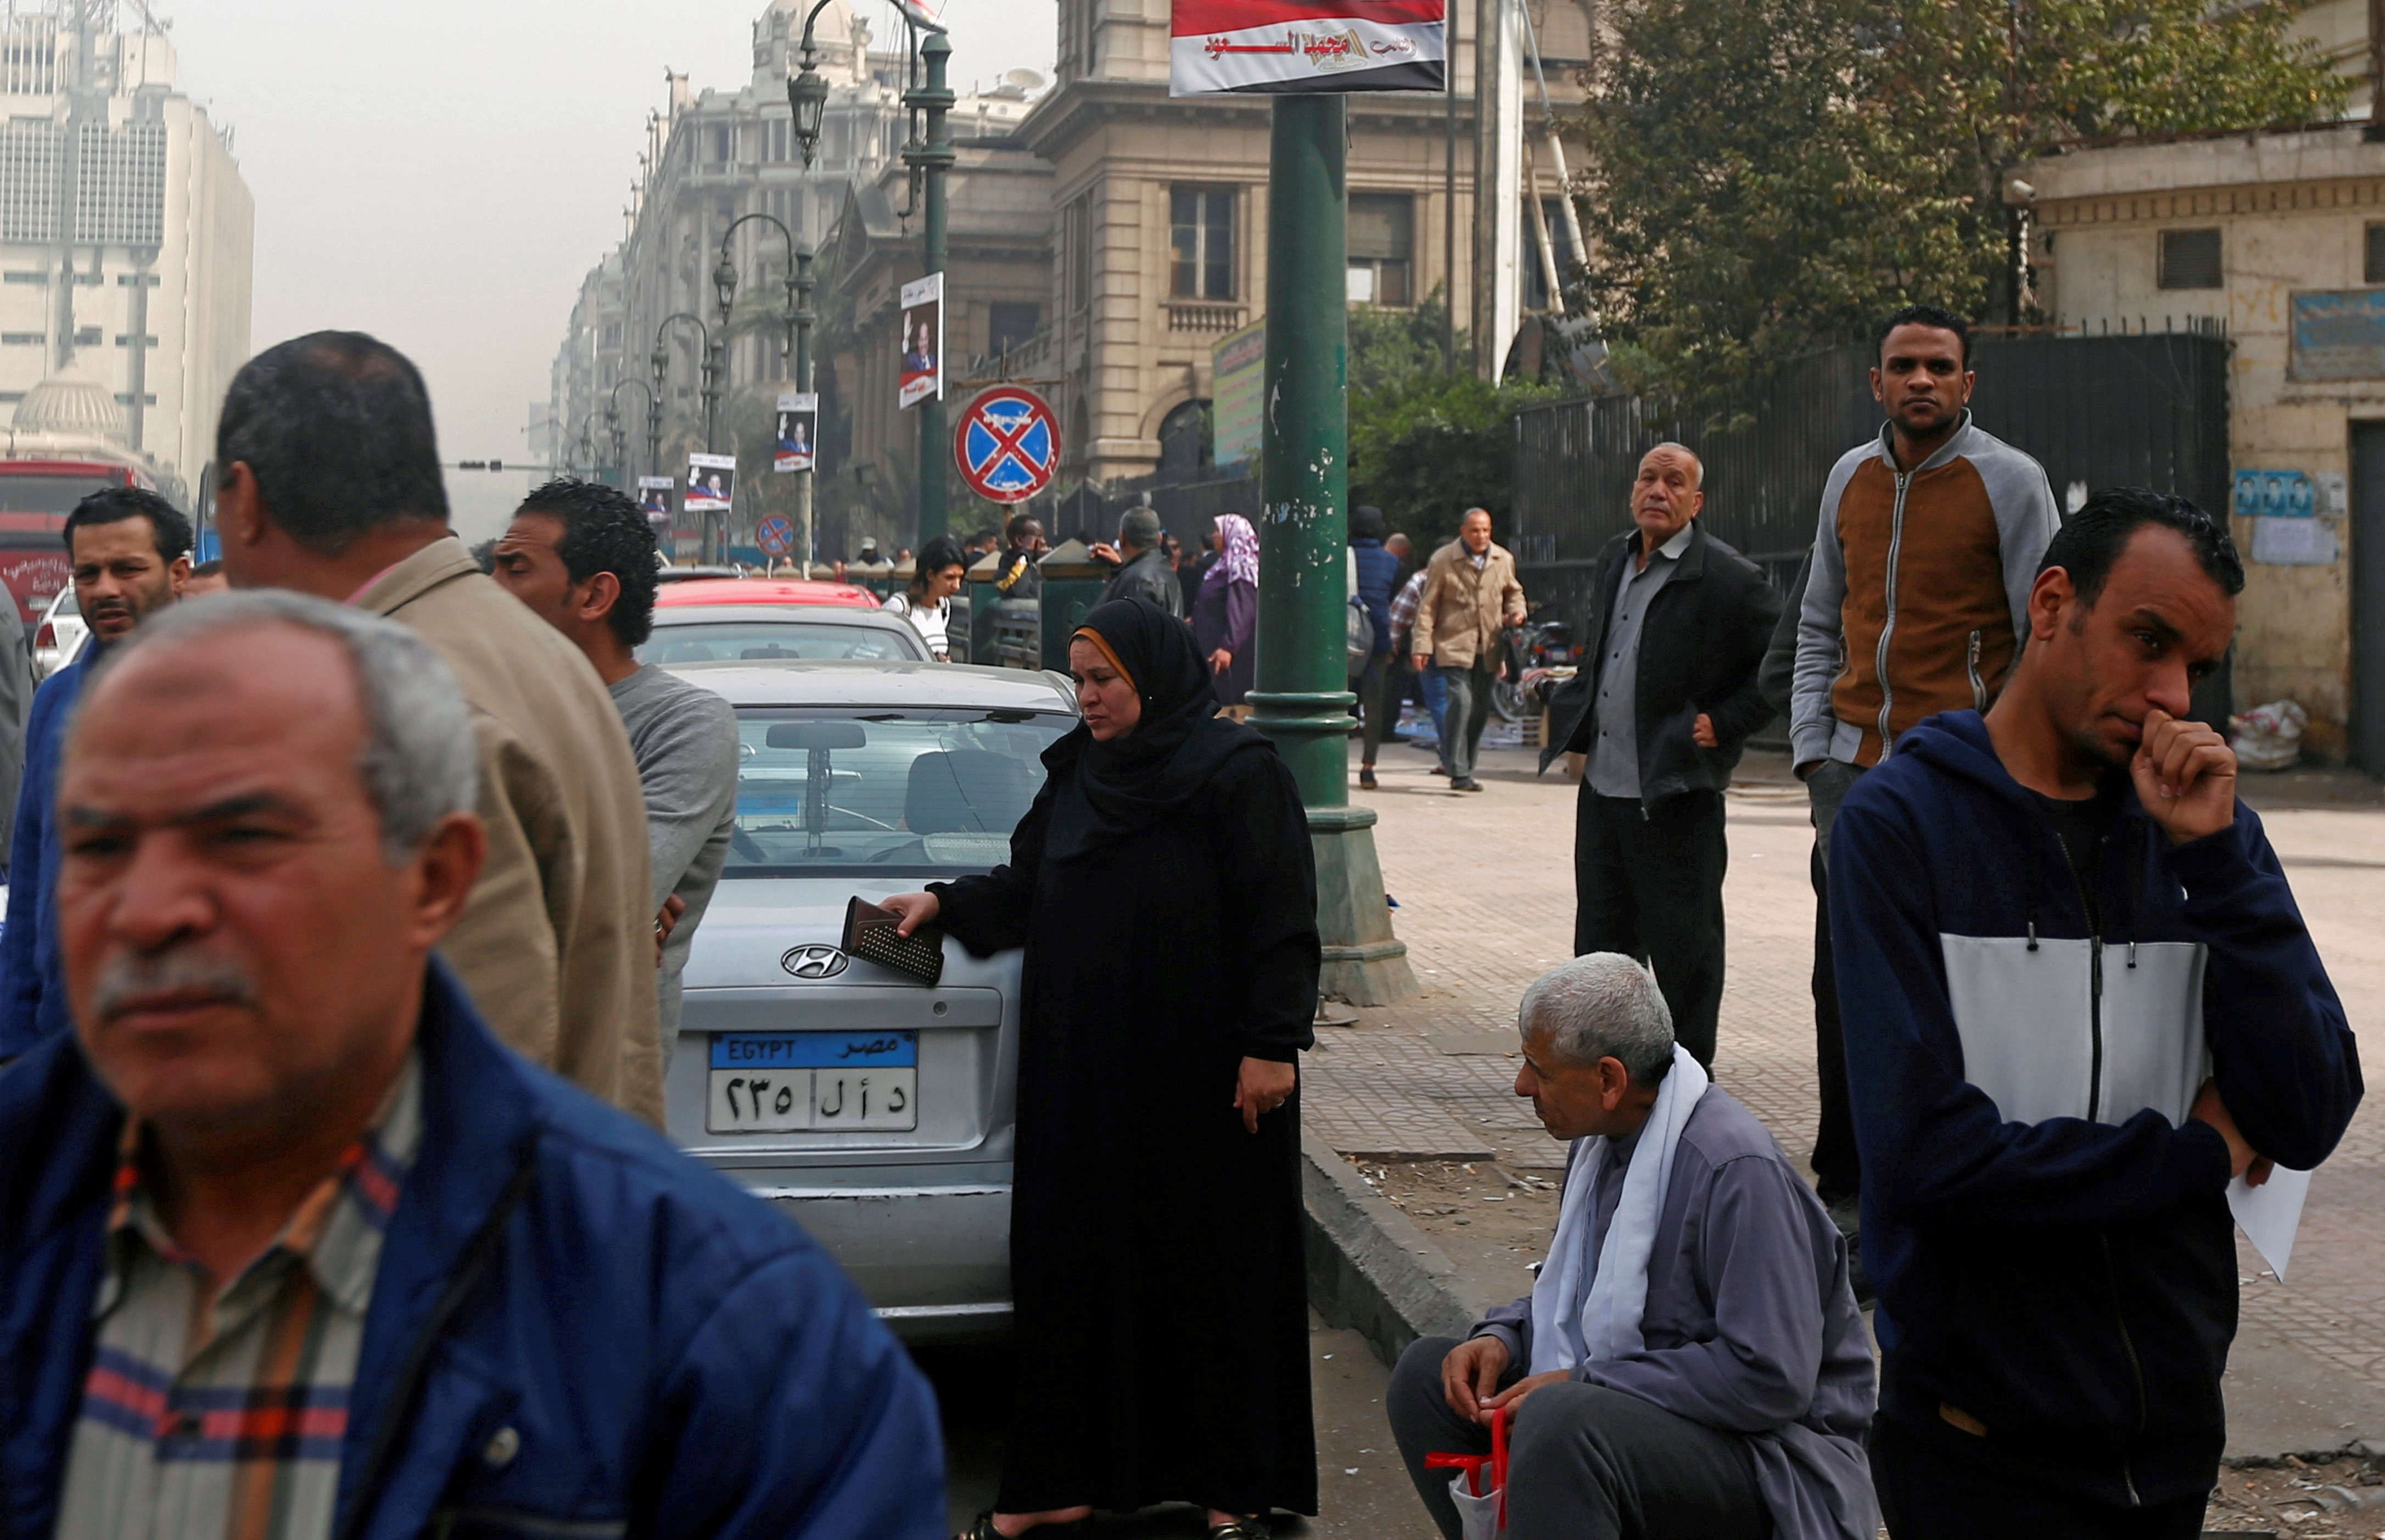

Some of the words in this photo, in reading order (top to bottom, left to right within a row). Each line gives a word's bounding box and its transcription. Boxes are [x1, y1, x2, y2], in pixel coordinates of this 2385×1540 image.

[1304, 33, 1350, 55] محمد
[729, 1039, 796, 1060] EGYPT
[837, 1039, 898, 1059] مصر
[727, 1078, 792, 1121] ٢٣٥
